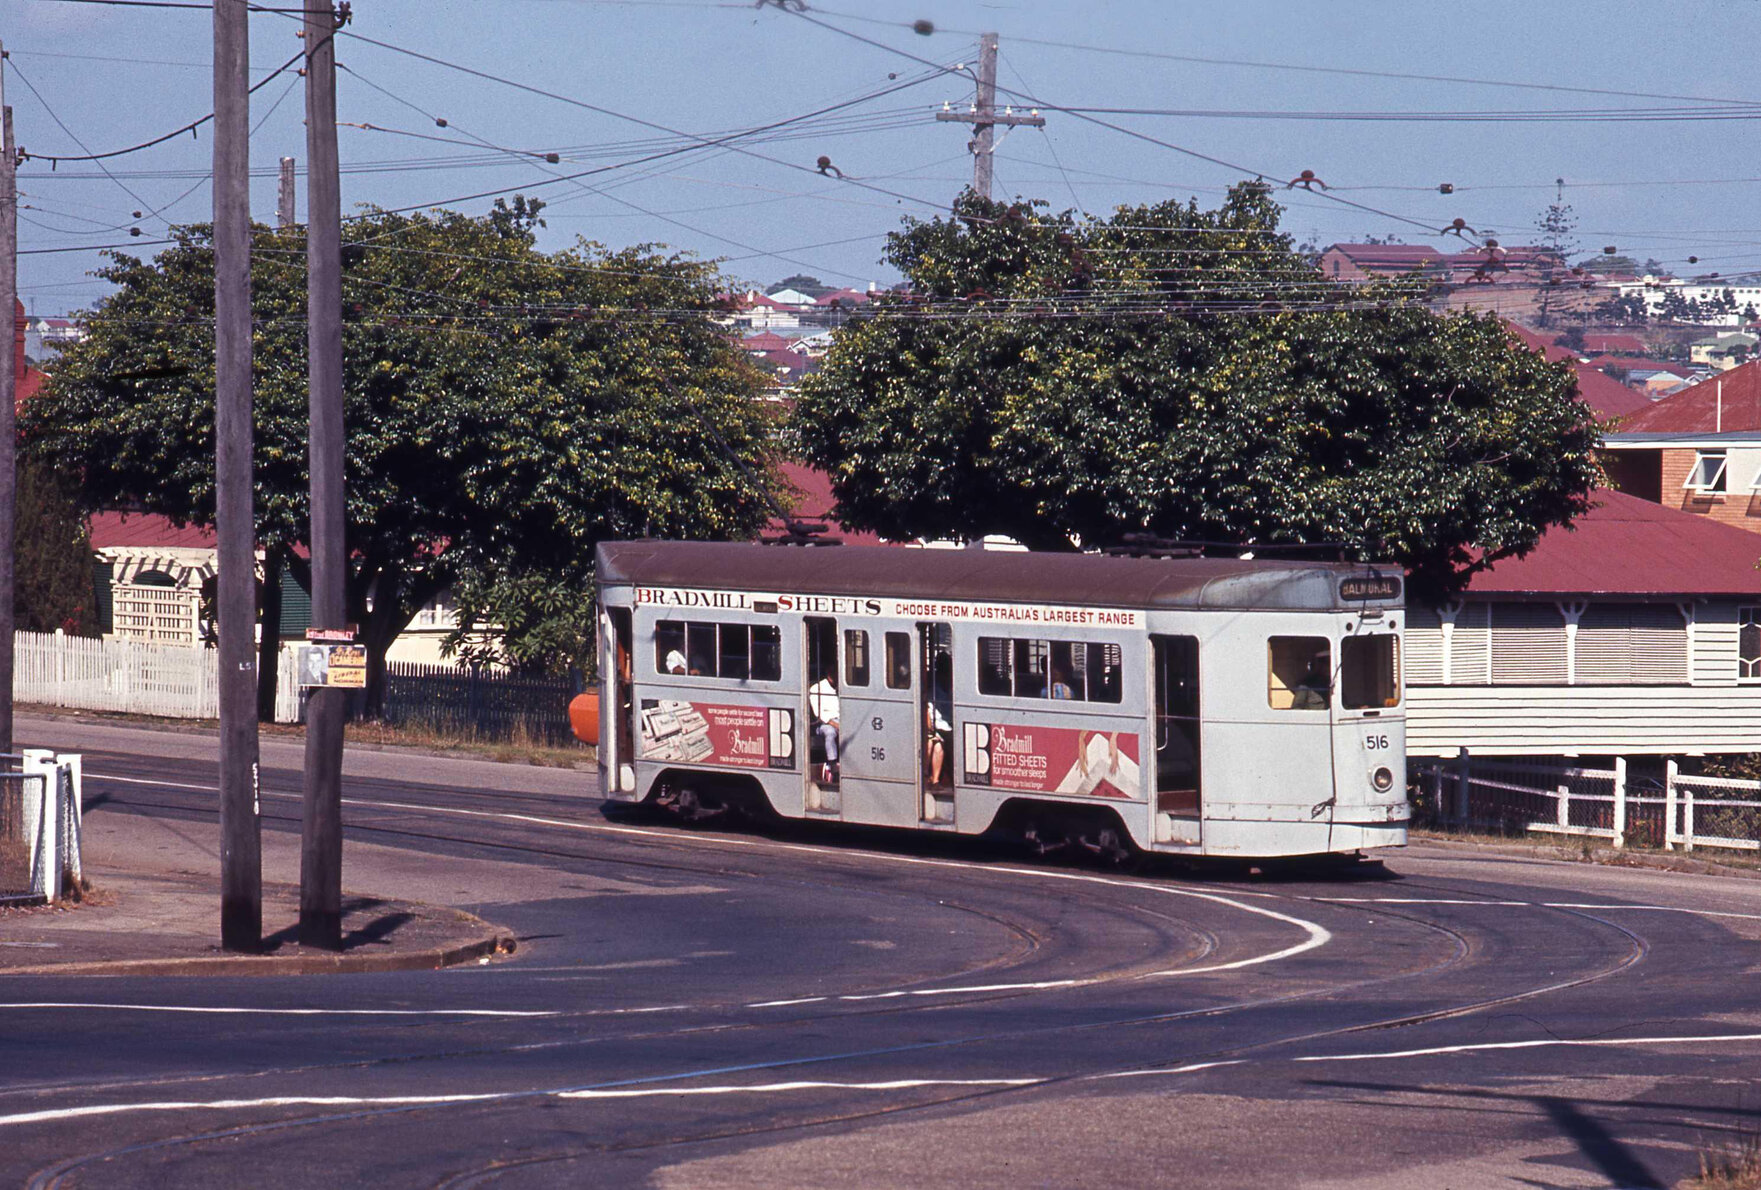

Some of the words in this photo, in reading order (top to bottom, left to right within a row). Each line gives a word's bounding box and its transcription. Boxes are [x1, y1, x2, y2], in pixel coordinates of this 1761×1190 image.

[636, 588, 751, 610] BRADMILL
[778, 595, 881, 616] SHEETS
[896, 603, 937, 616] CHOOSE
[941, 605, 969, 618] FROM
[973, 607, 1039, 621] AUSTRALIA'S
[1043, 610, 1094, 623] LARGEST
[1098, 612, 1135, 625] RANGE
[715, 717, 727, 725] most
[727, 717, 744, 727] people
[728, 729, 764, 755] Bradmill
[992, 726, 1032, 753] Bradmill
[1366, 735, 1389, 750] 516
[871, 746, 885, 761] 516
[993, 753, 1017, 765] FITTED
[1019, 756, 1047, 768] SHEETS
[993, 765, 1001, 774] for
[1001, 767, 1028, 776] smoother
[1029, 769, 1046, 779] sleeps
